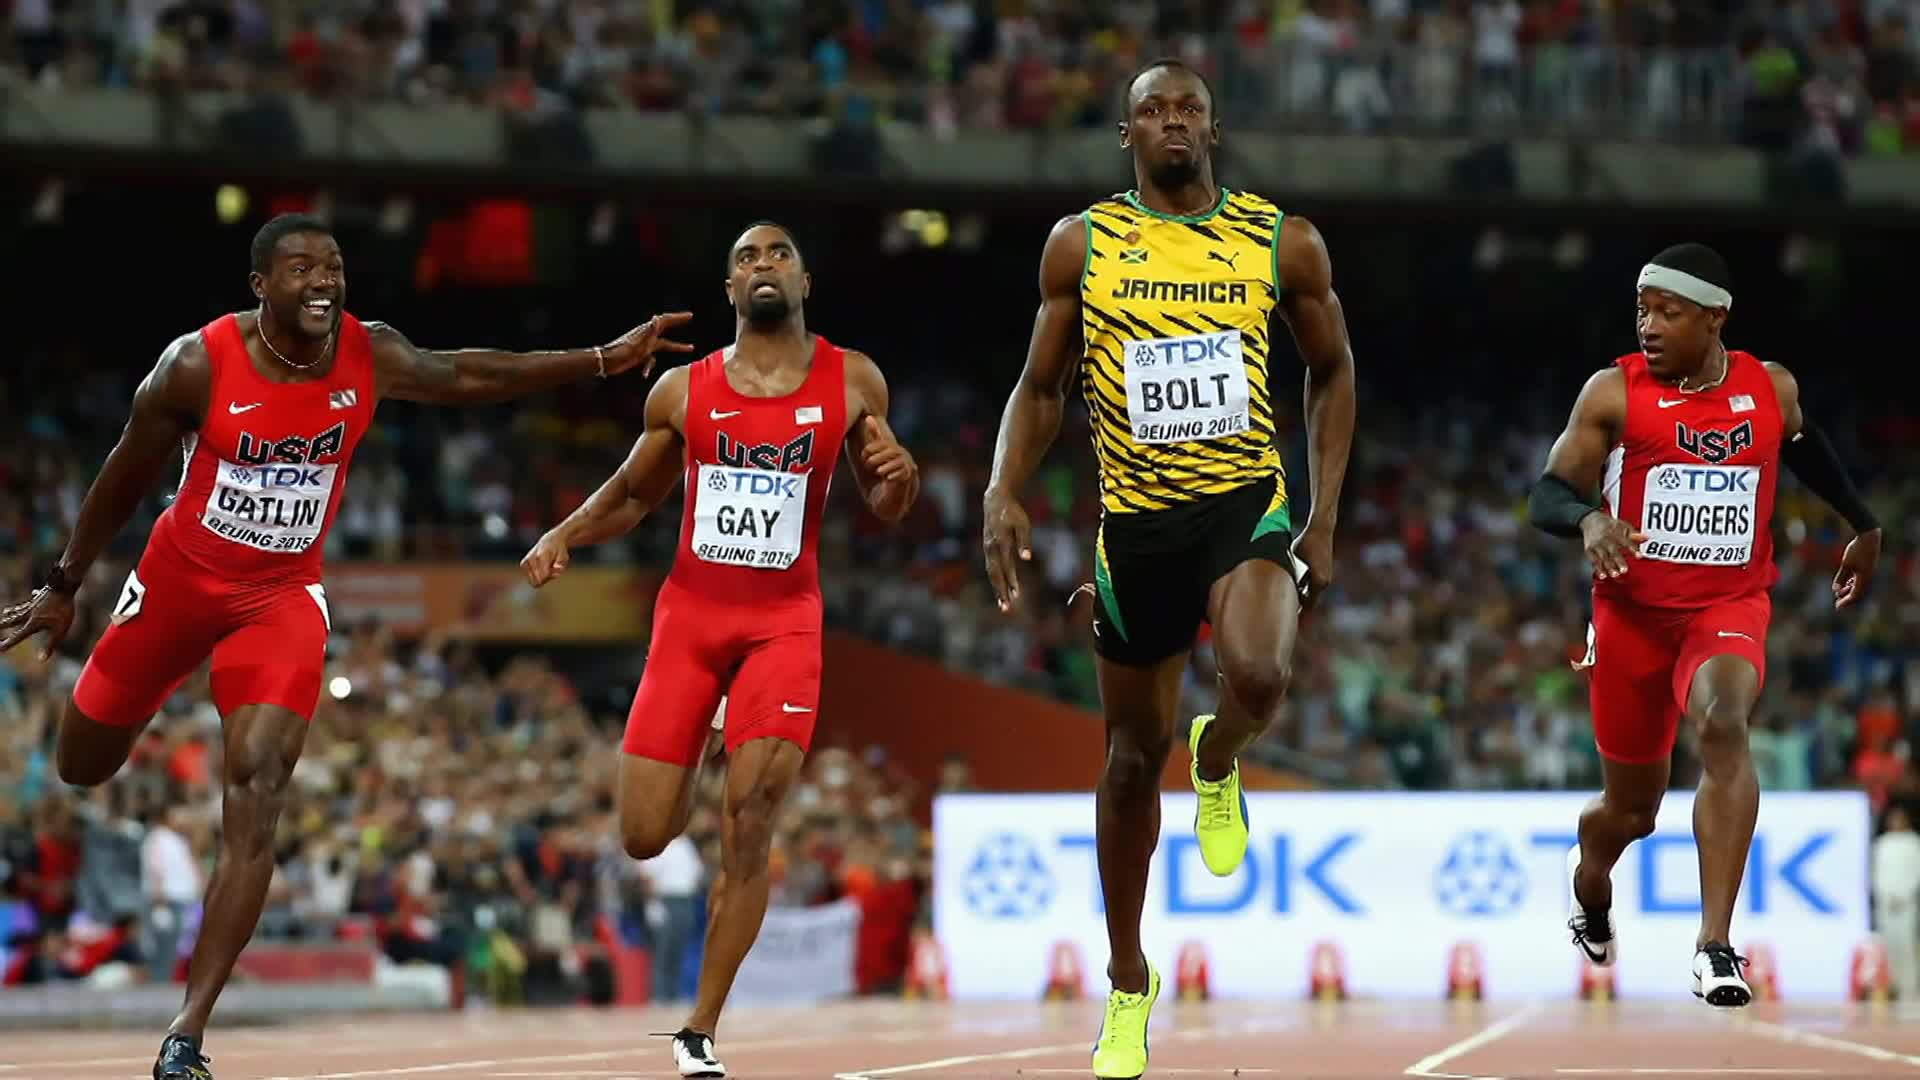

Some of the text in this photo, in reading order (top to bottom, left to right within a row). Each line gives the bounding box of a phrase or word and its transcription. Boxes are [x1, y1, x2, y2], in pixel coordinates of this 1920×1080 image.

[1112, 278, 1246, 304] JAMAICA
[1155, 335, 1231, 365] TDK
[1141, 373, 1229, 412] BOLT
[1138, 413, 1243, 440] BEIJING 2015
[1676, 419, 1752, 464] USA
[236, 420, 345, 464] USA
[716, 429, 814, 472] USA
[254, 467, 323, 487] TDK
[728, 472, 800, 497] TDK
[1682, 469, 1749, 492] TDK
[218, 487, 319, 527] GATLIN
[717, 505, 781, 538] GAY
[1647, 502, 1749, 535] RODGERS
[208, 517, 312, 550] BEIJING 2015
[699, 543, 793, 565] BEIJING 2015
[1646, 541, 1745, 562] BEIJING 2015
[119, 586, 138, 615] 7
